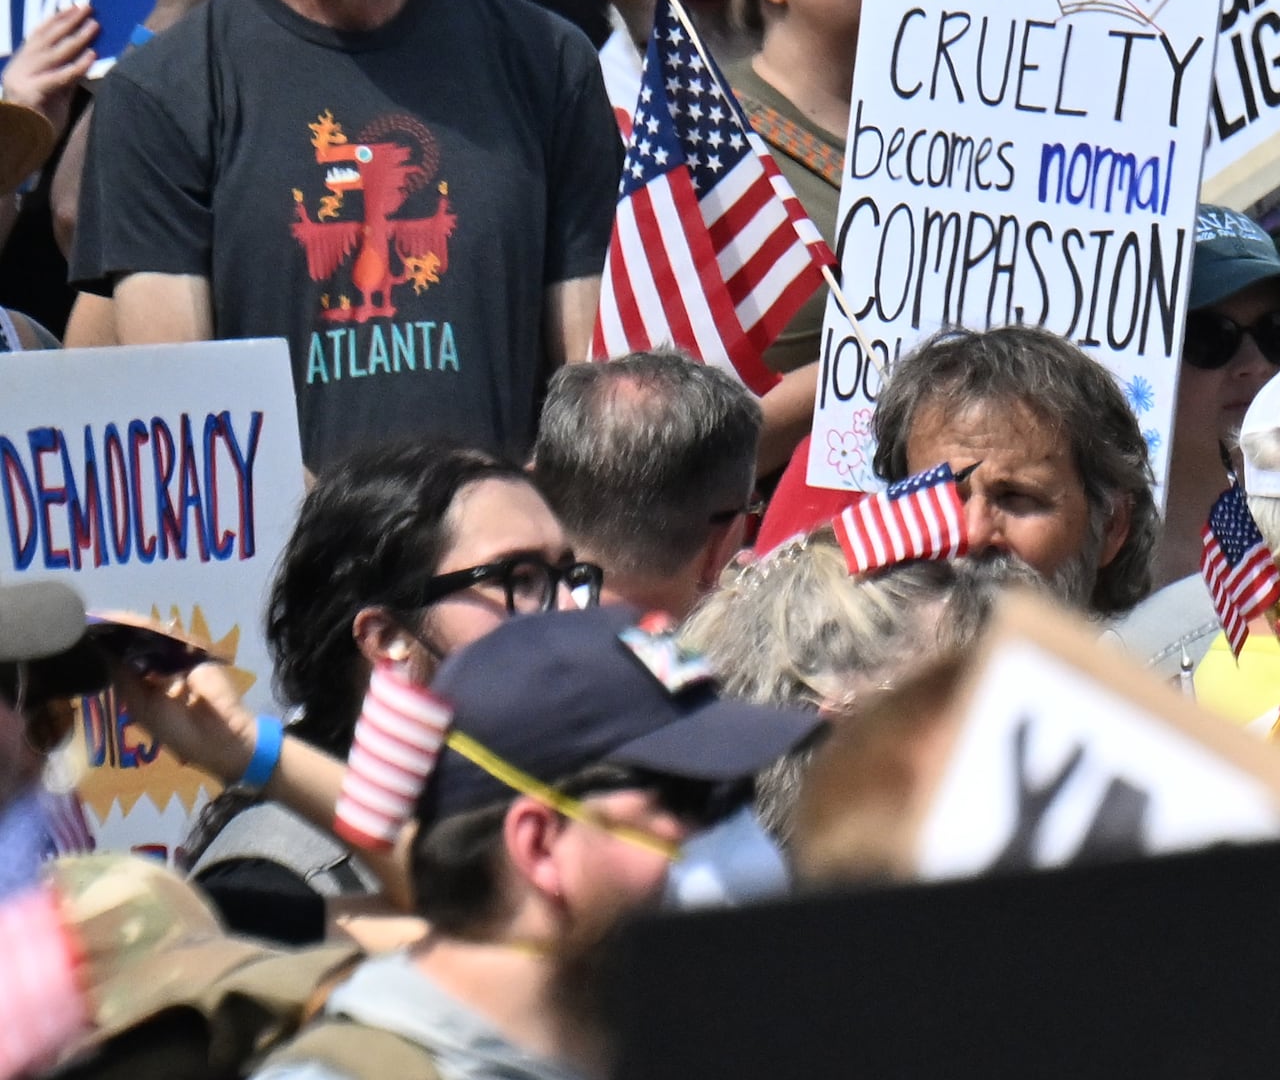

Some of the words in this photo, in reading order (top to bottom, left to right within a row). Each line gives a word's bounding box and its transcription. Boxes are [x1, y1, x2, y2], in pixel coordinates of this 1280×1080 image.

[889, 7, 1204, 128] CRUELTY
[850, 99, 1015, 193] becomes
[1038, 139, 1176, 217] normal
[834, 197, 1186, 358] COMPASSION
[306, 321, 459, 384] ATLANTA
[0, 411, 263, 572] DEMOCRACY
